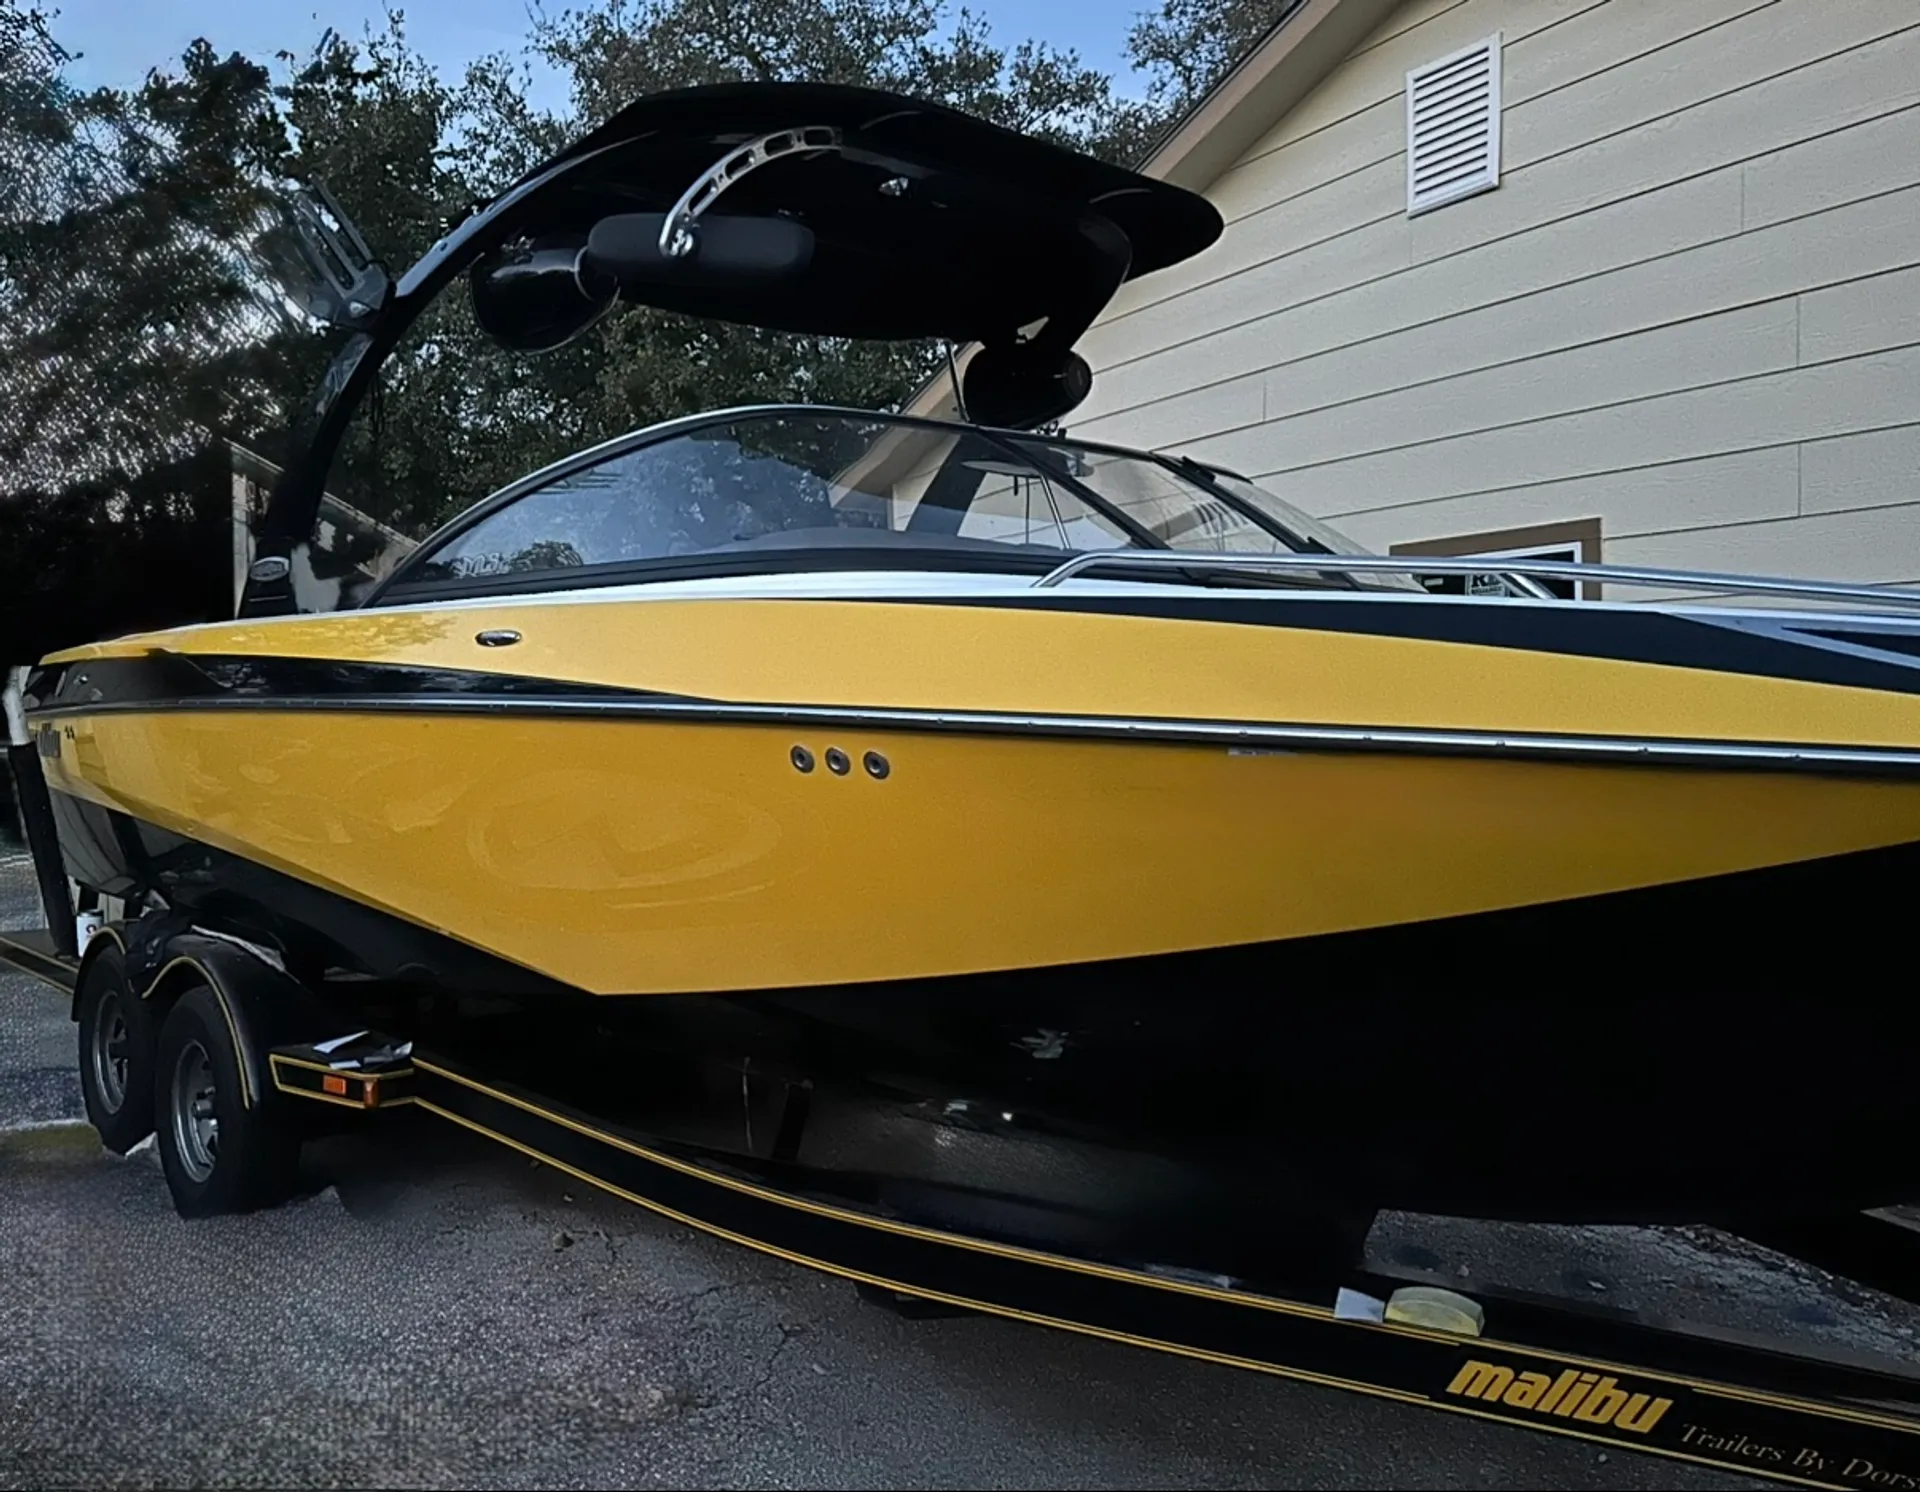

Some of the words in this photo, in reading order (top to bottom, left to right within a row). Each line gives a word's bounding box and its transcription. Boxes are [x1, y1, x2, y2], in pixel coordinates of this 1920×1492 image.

[1446, 1360, 1673, 1433] malibu
[1682, 1423, 1786, 1460] Trailers
[1792, 1448, 1834, 1475] By
[1842, 1458, 1920, 1490] Dors
